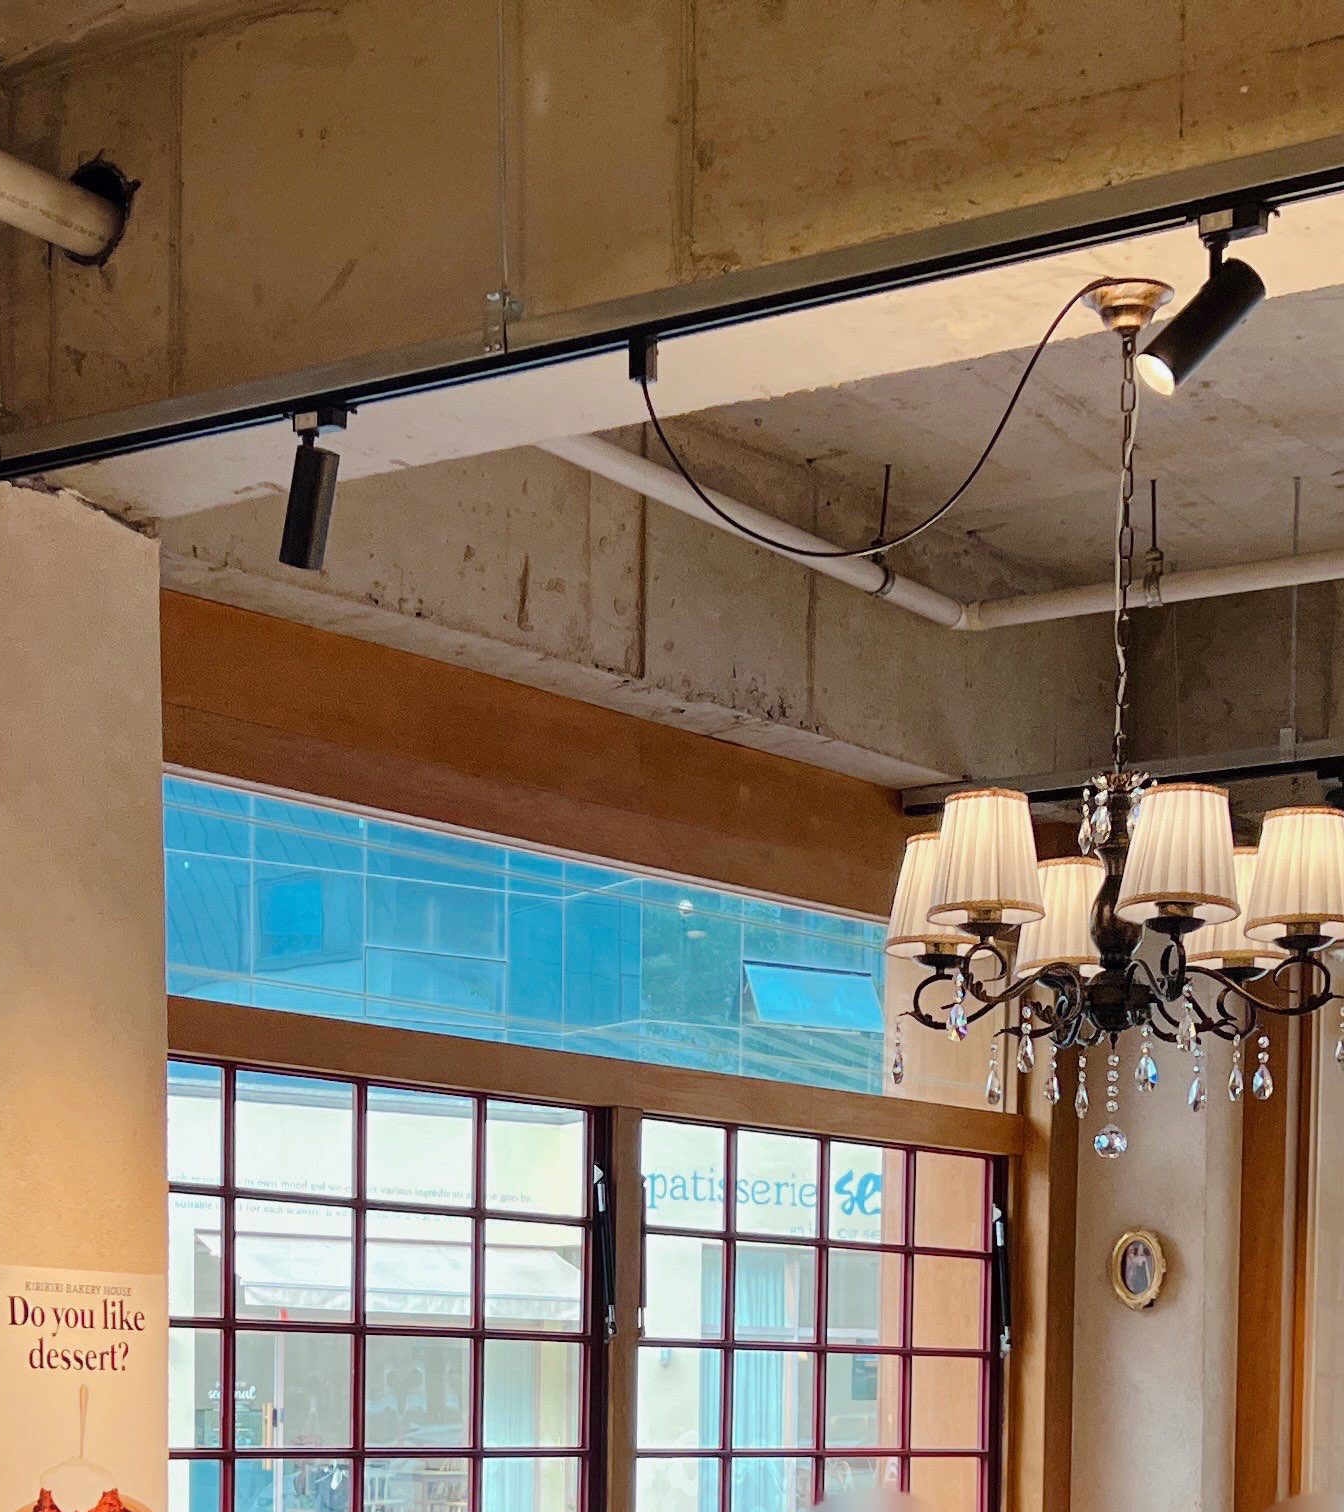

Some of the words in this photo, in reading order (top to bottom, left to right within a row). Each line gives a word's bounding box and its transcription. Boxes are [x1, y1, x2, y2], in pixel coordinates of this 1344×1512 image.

[646, 1168, 816, 1210] patisserie
[6, 1295, 45, 1328] Do
[50, 1306, 96, 1338] you
[102, 1298, 146, 1332] like
[28, 1336, 130, 1372] dessert?
